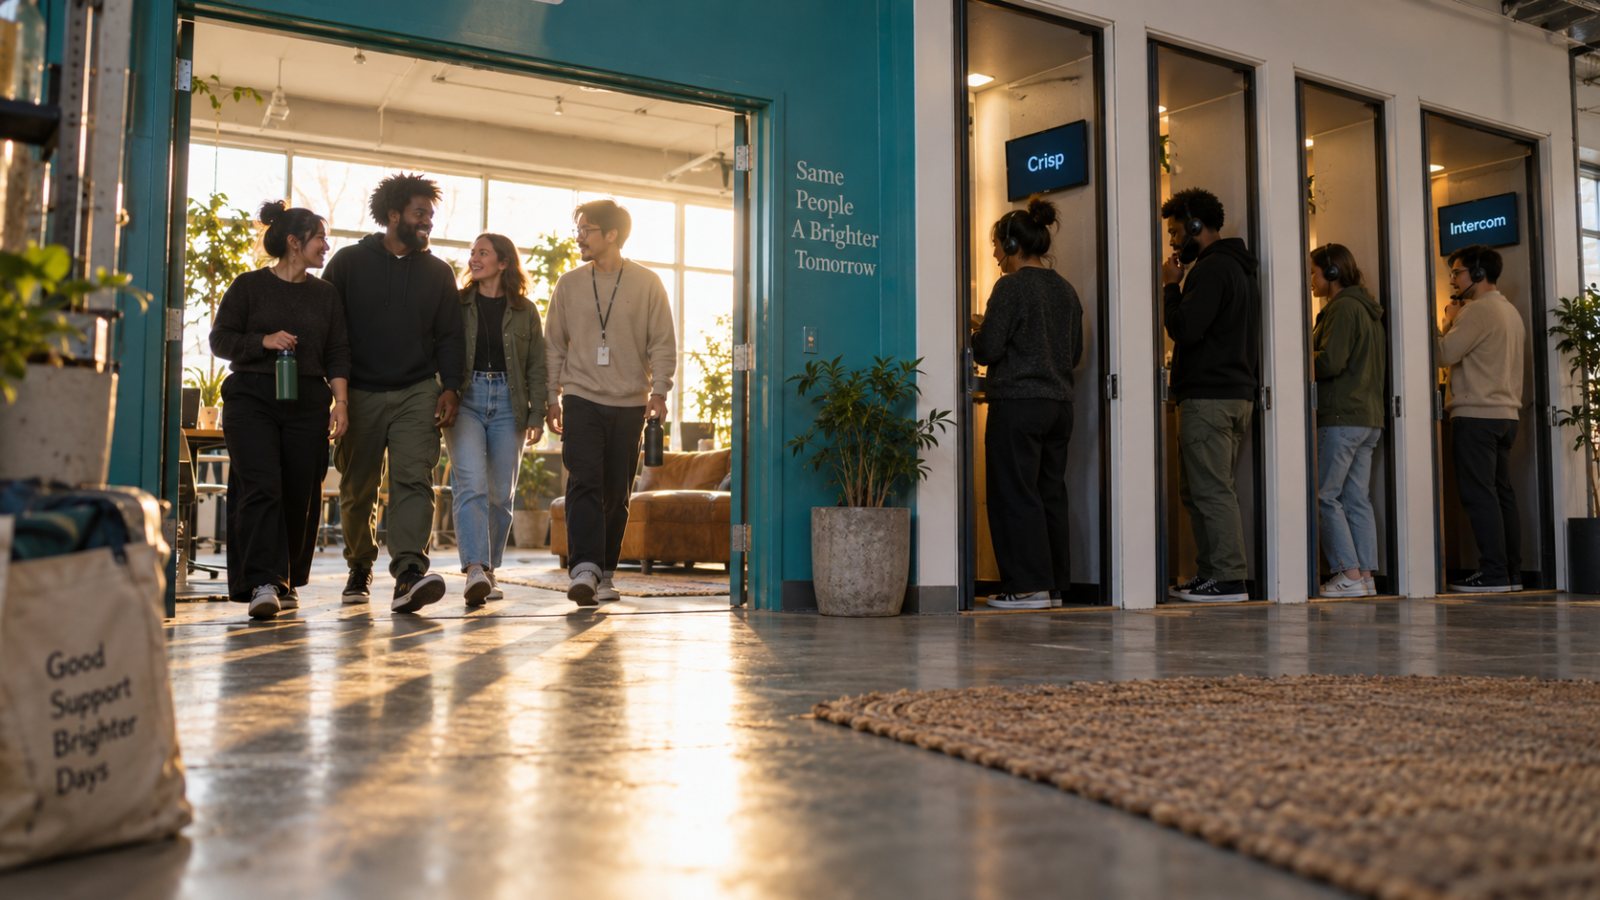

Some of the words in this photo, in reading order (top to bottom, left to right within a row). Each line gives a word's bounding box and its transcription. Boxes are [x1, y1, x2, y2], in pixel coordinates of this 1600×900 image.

[796, 160, 844, 186] Same
[1027, 153, 1065, 172] Crisp
[796, 189, 854, 219] People
[791, 219, 805, 239] A
[810, 220, 879, 250] Brighter
[1450, 216, 1506, 235] Intercom
[795, 249, 877, 276] Tomorrow
[46, 642, 105, 679] Good
[50, 676, 131, 719] Support
[53, 714, 137, 758] Brighter
[55, 762, 110, 796] Days
